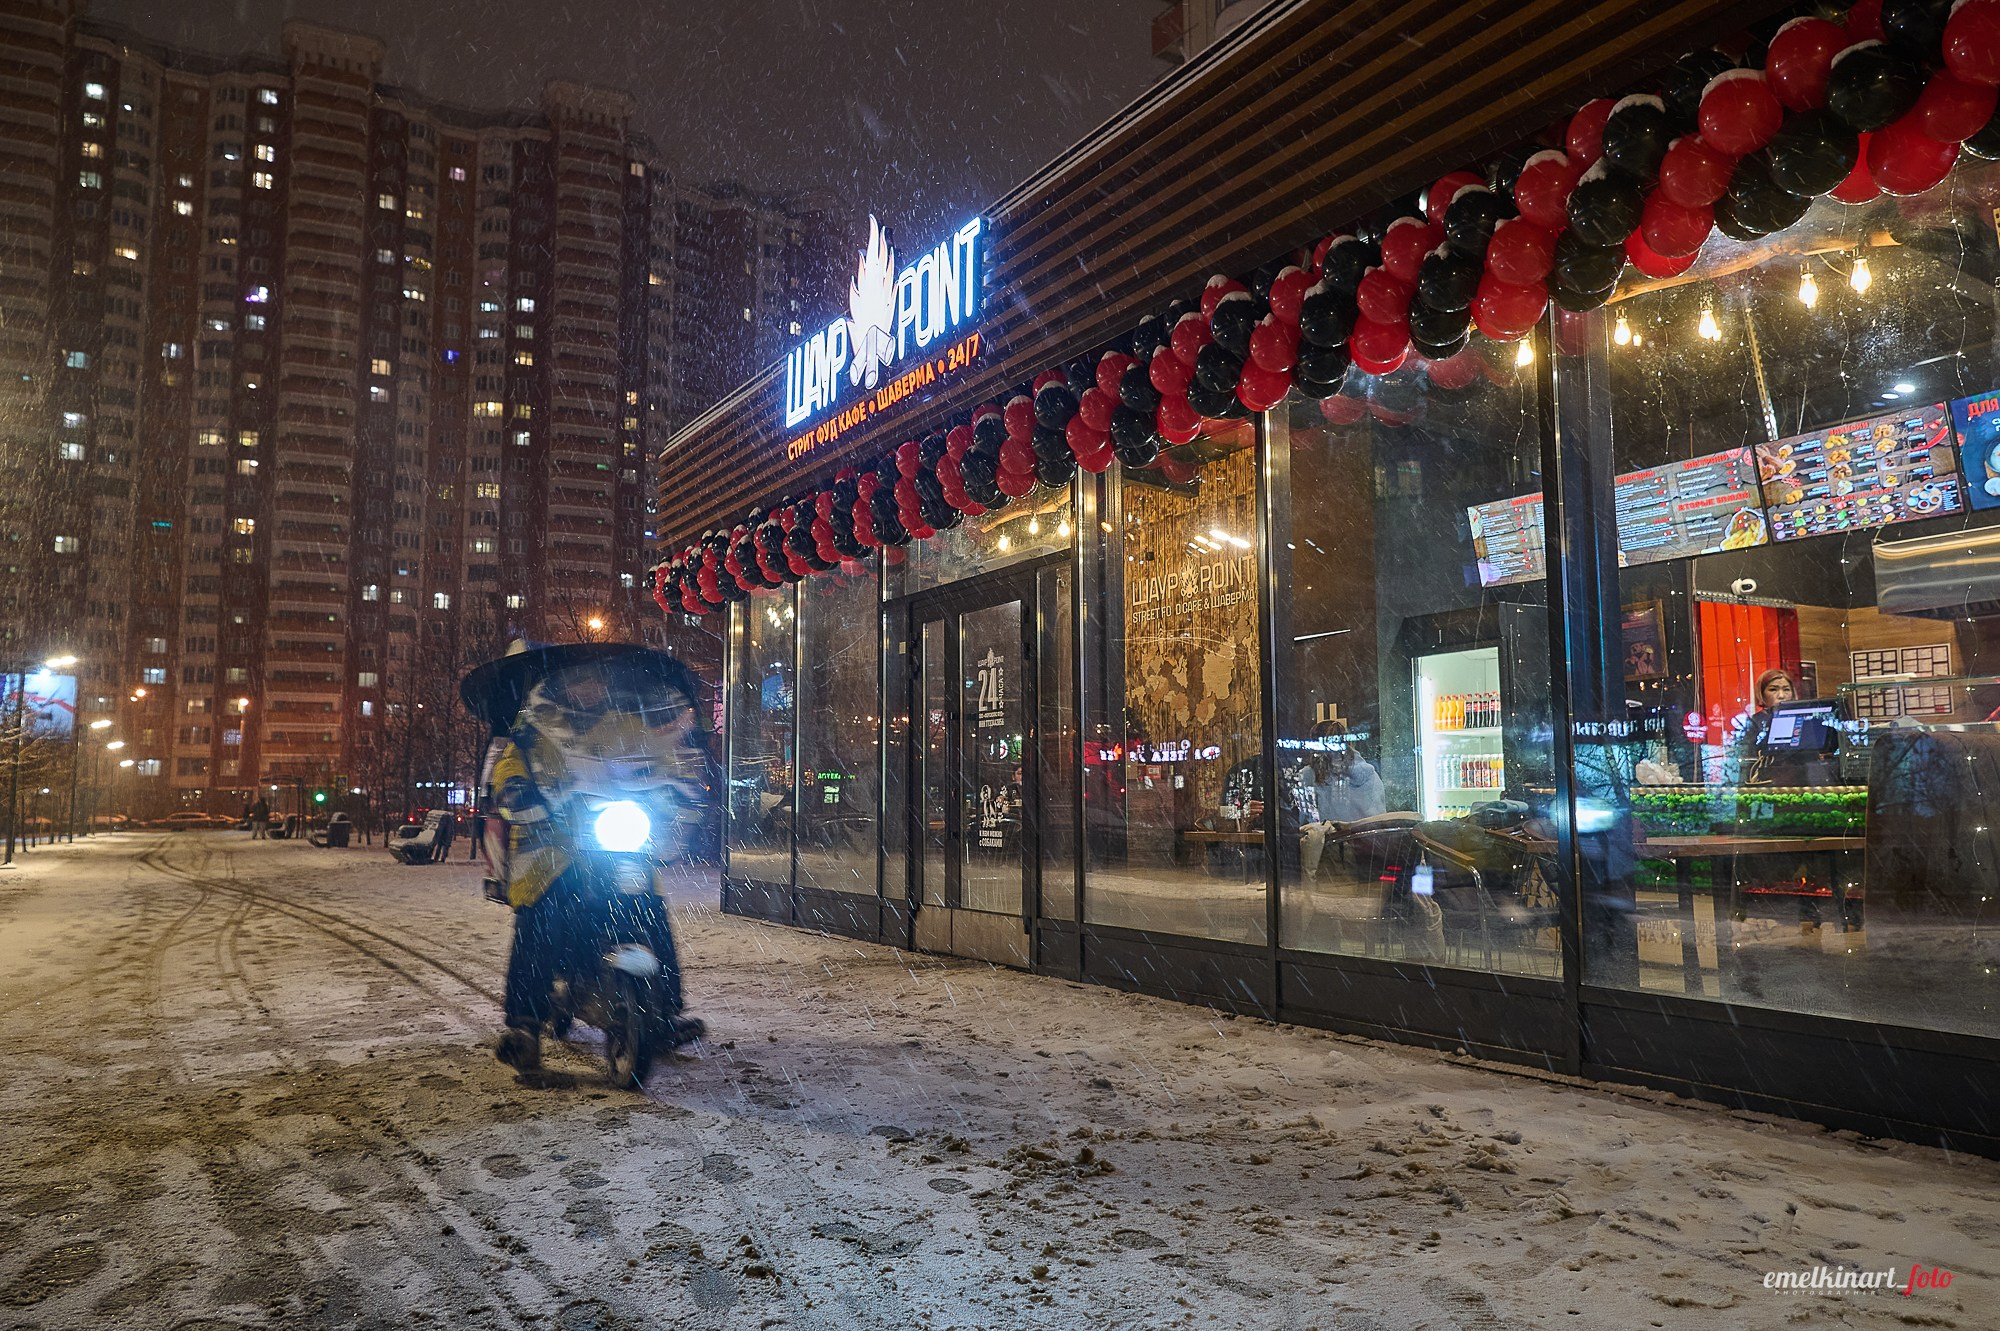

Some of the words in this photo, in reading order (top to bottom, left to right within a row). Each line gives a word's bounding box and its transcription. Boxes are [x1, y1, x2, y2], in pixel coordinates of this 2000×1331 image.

[785, 317, 848, 429] ШАУР
[896, 216, 982, 360] POINT
[787, 431, 815, 461] СТРИТ
[816, 419, 838, 446] ФУД
[838, 402, 868, 432] КАФЕ
[876, 366, 936, 411] ШАВЕРМА
[947, 332, 981, 370] 24/7
[1968, 397, 2000, 418] ДЛЯ
[1132, 572, 1179, 606] ШАУР
[1200, 555, 1256, 592] POINT
[1132, 607, 1161, 623] STREET
[1183, 598, 1203, 614] CAFE
[1204, 598, 1210, 609] &
[1211, 589, 1256, 608] ШАВЕРМА
[978, 667, 999, 711] 24
